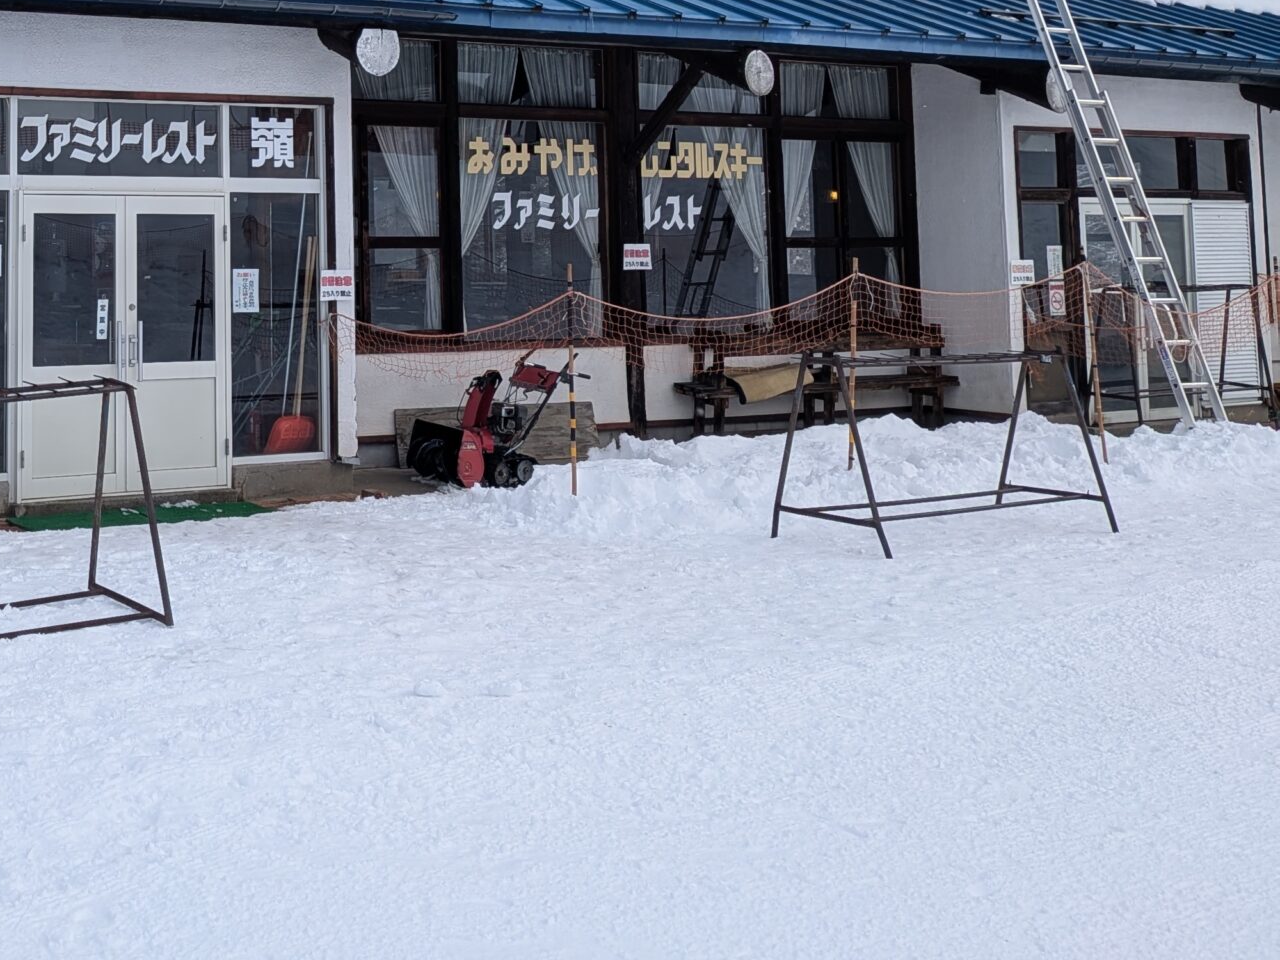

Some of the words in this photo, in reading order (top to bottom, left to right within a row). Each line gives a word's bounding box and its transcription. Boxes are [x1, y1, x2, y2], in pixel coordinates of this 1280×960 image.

[20, 113, 217, 165] ファミリーレスト
[251, 116, 295, 168] 嶺
[467, 136, 599, 177] おみやげ
[640, 141, 763, 180] レンタルスキー
[492, 191, 600, 230] ファミリー
[643, 194, 703, 231] レスト
